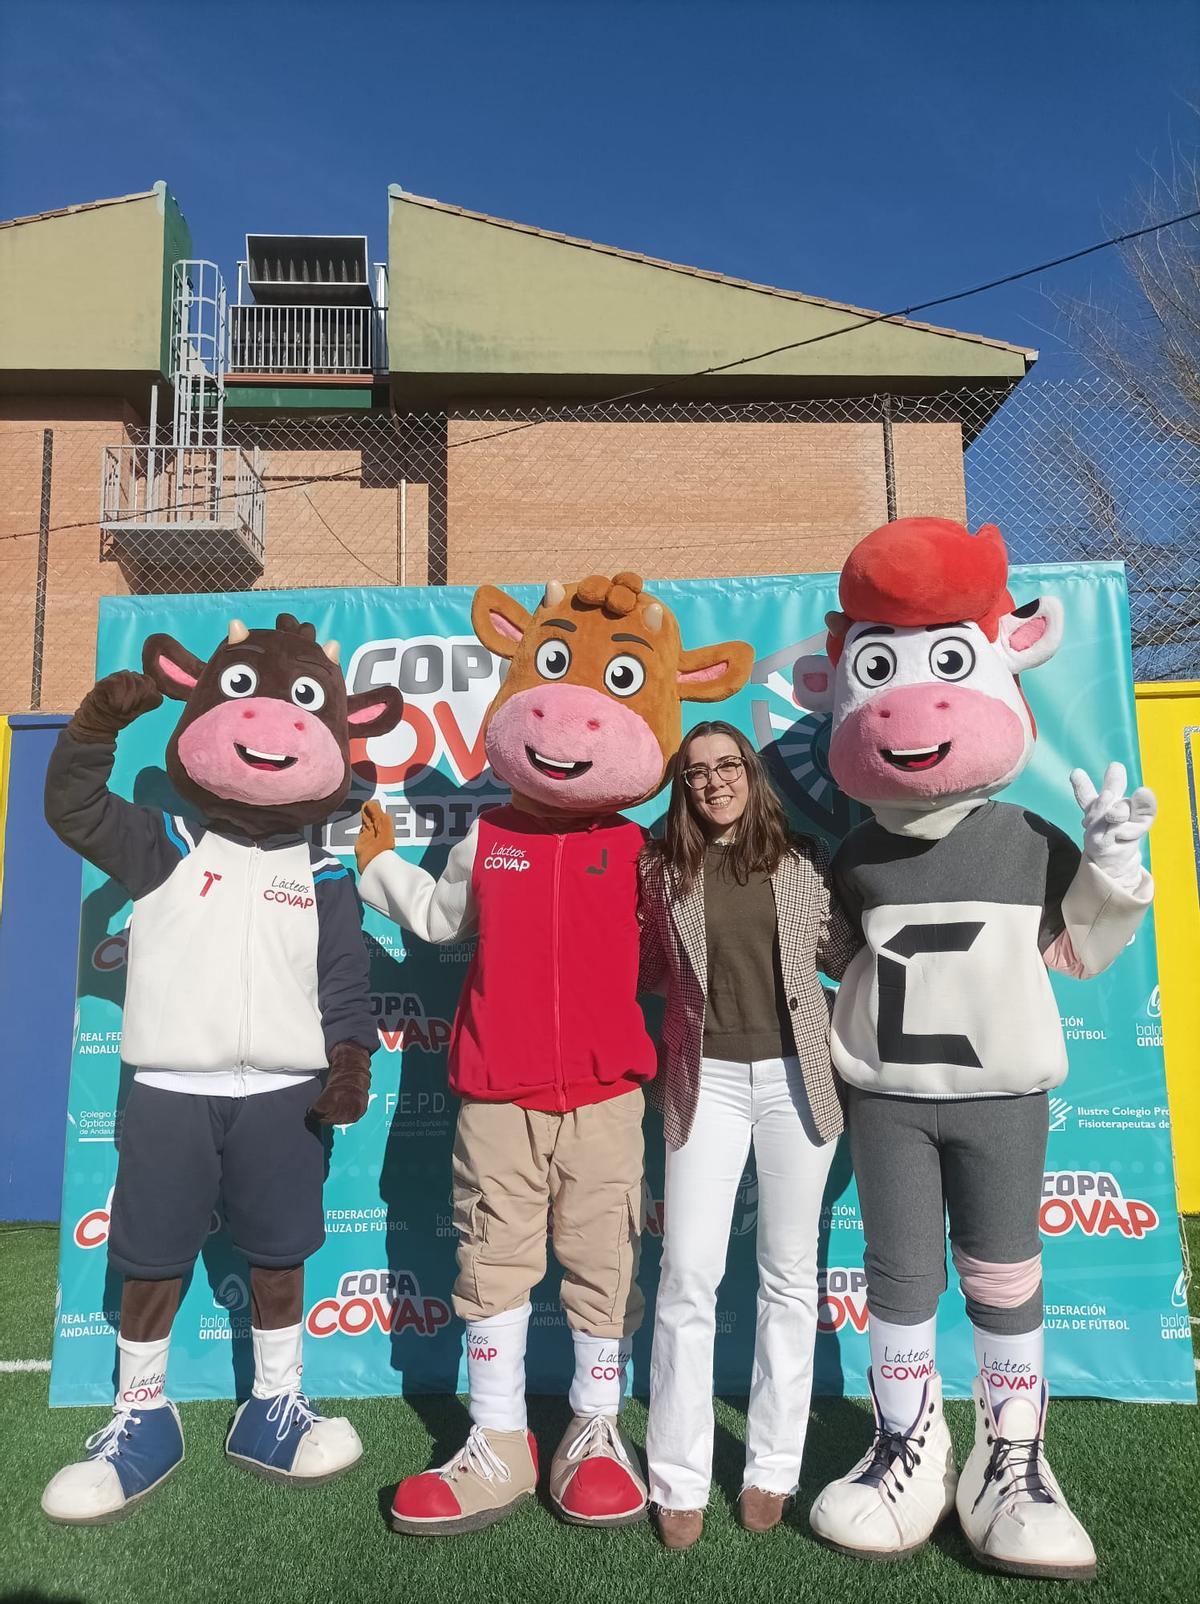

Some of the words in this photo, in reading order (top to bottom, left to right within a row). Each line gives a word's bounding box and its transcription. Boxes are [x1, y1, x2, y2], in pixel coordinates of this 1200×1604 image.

[353, 645, 510, 695] COP
[490, 842, 527, 859] Lácteos
[484, 857, 530, 872] COVAP
[585, 848, 607, 875] J
[199, 871, 222, 897] T
[271, 875, 310, 894] Lácteos
[263, 889, 314, 910] COVAP
[877, 922, 986, 1068] C
[80, 1033, 103, 1042] REAL
[1066, 1029, 1107, 1040] FÚTBOL
[80, 1110, 111, 1120] Colegio
[1077, 1107, 1110, 1116] Ilustre
[1112, 1106, 1151, 1118] Colegio
[1078, 1119, 1156, 1131] Fisioterapeutas
[1158, 1119, 1170, 1129] de
[326, 1207, 388, 1219] FEDERACIÓN
[354, 1222, 368, 1233] DE
[370, 1220, 409, 1232] FÚTBOL
[339, 1273, 417, 1297] COPA
[61, 1313, 87, 1324] REAL
[307, 1297, 450, 1336] COVAP
[1073, 1319, 1088, 1330] DE
[1089, 1316, 1130, 1331] FÚTBOL
[60, 1326, 116, 1338] ANDALUZA
[884, 1345, 930, 1364] Lácteos
[983, 1351, 1032, 1374] Lácteos
[880, 1359, 936, 1380] COVAP
